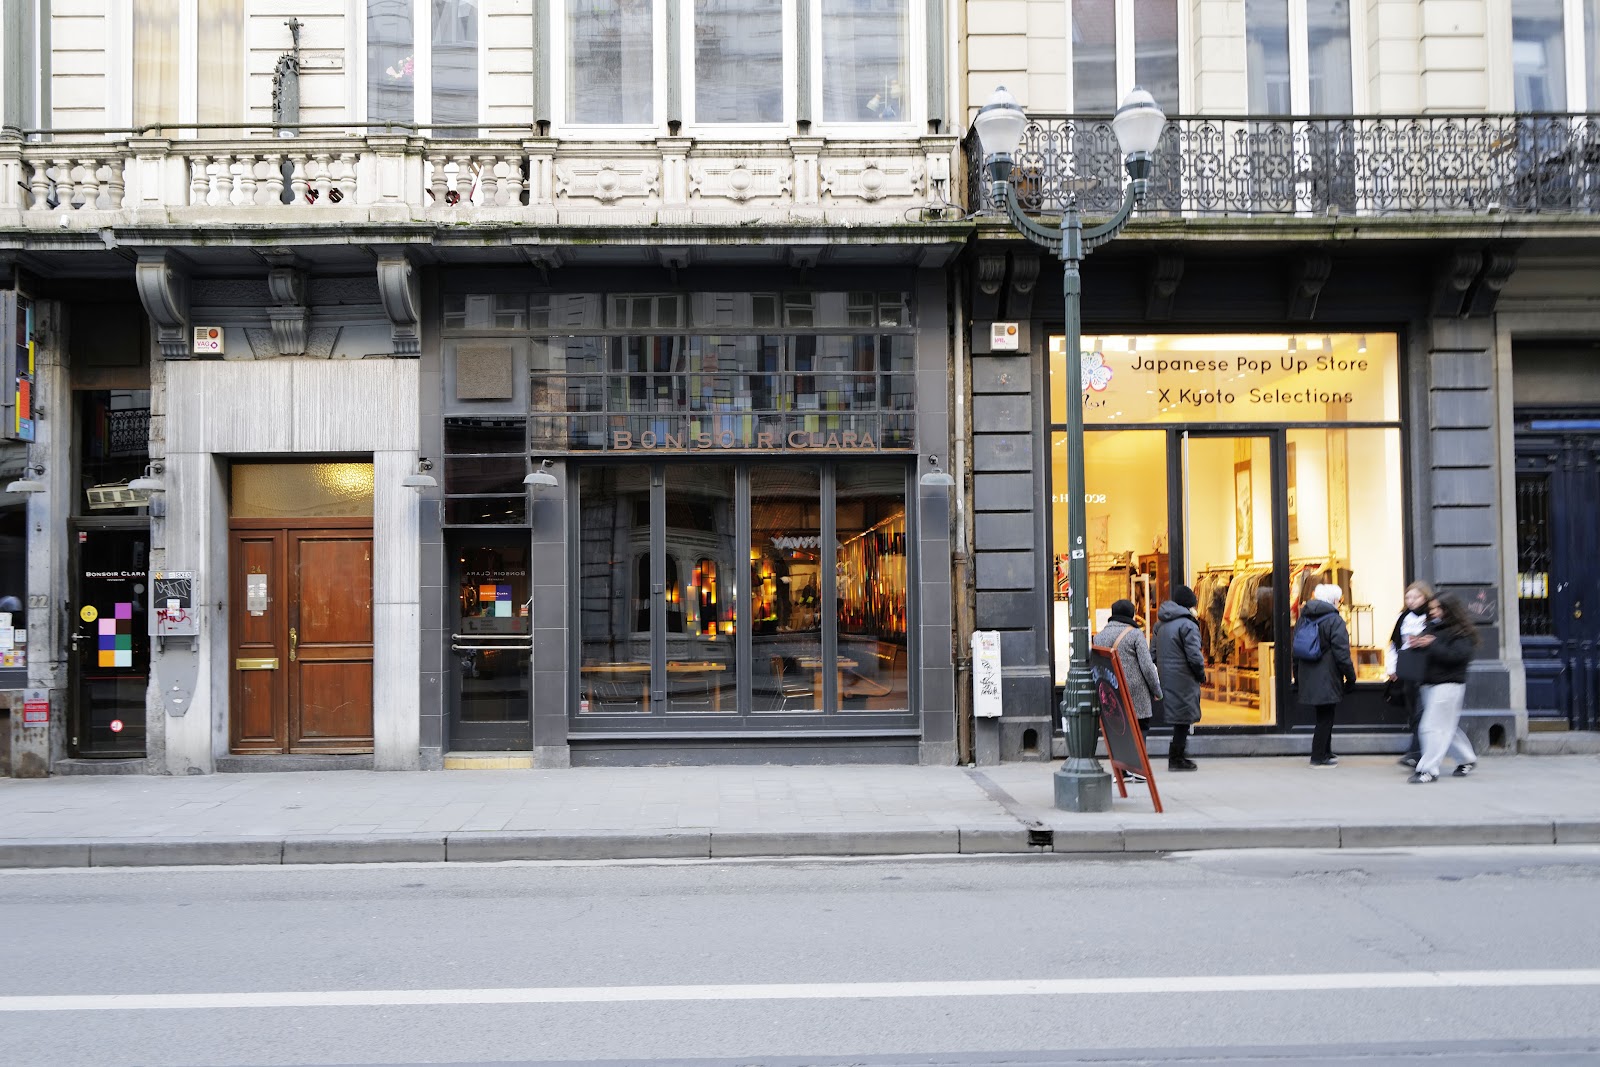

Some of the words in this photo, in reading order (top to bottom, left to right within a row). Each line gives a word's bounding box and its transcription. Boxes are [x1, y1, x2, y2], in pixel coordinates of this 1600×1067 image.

[1131, 356, 1229, 374] Japanese
[1237, 356, 1272, 374] Pop
[1280, 356, 1308, 374] Up
[1316, 355, 1368, 371] Store
[1158, 388, 1170, 403] X
[1179, 388, 1235, 407] Kyoto
[1249, 388, 1353, 403] Selections
[613, 430, 775, 450] BONSOIR
[787, 430, 876, 449] CLARA
[1076, 535, 1083, 545] 6
[29, 595, 48, 609] 22
